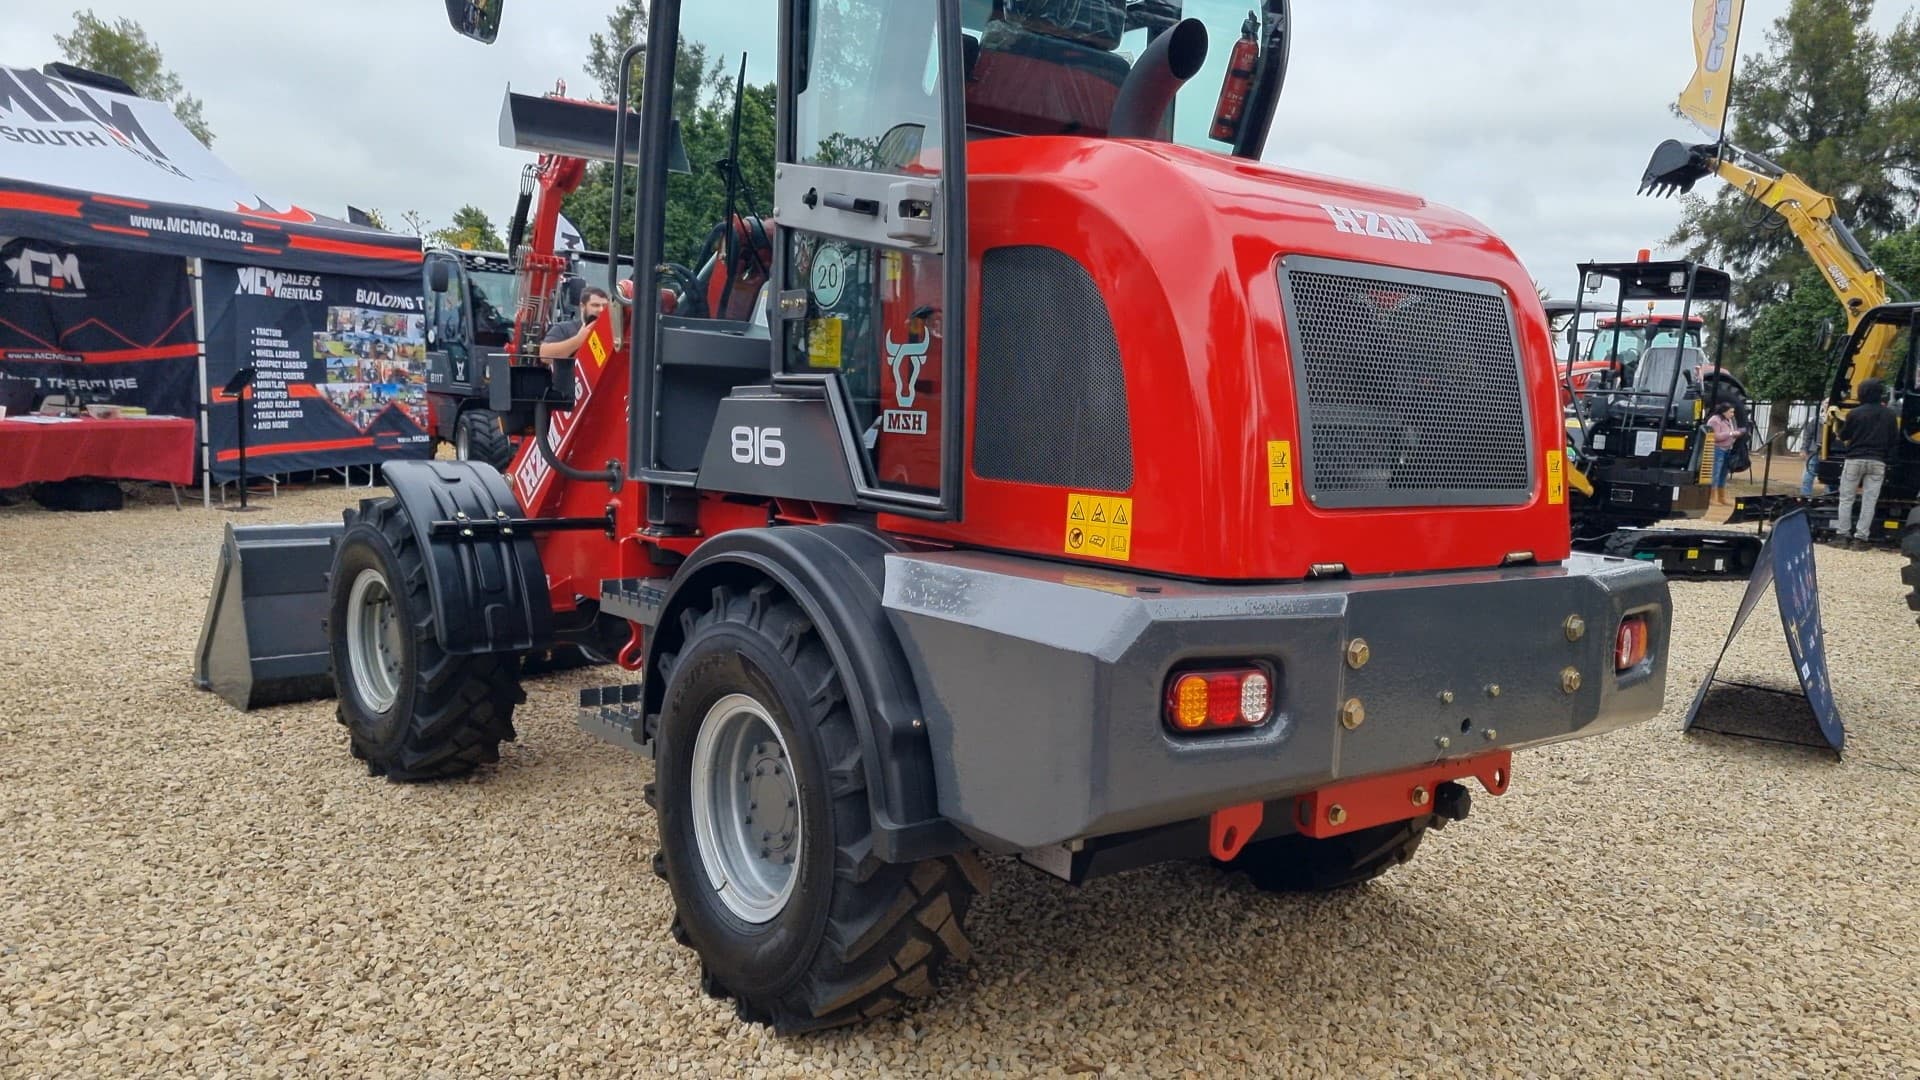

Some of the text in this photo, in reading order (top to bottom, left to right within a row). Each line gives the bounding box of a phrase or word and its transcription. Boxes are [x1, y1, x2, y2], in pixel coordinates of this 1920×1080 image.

[0, 125, 108, 147] SOUTH
[129, 214, 255, 243] www.MCMCO.co.za
[1319, 203, 1433, 245] HZM
[235, 266, 282, 298] MCM
[281, 273, 321, 287] SALES &
[817, 263, 839, 290] 20
[280, 287, 323, 301] RENTALS
[356, 288, 414, 310] BUILDING
[257, 410, 304, 420] TRACK LOADERS
[258, 421, 289, 430] AND MORE
[731, 425, 786, 467] 816
